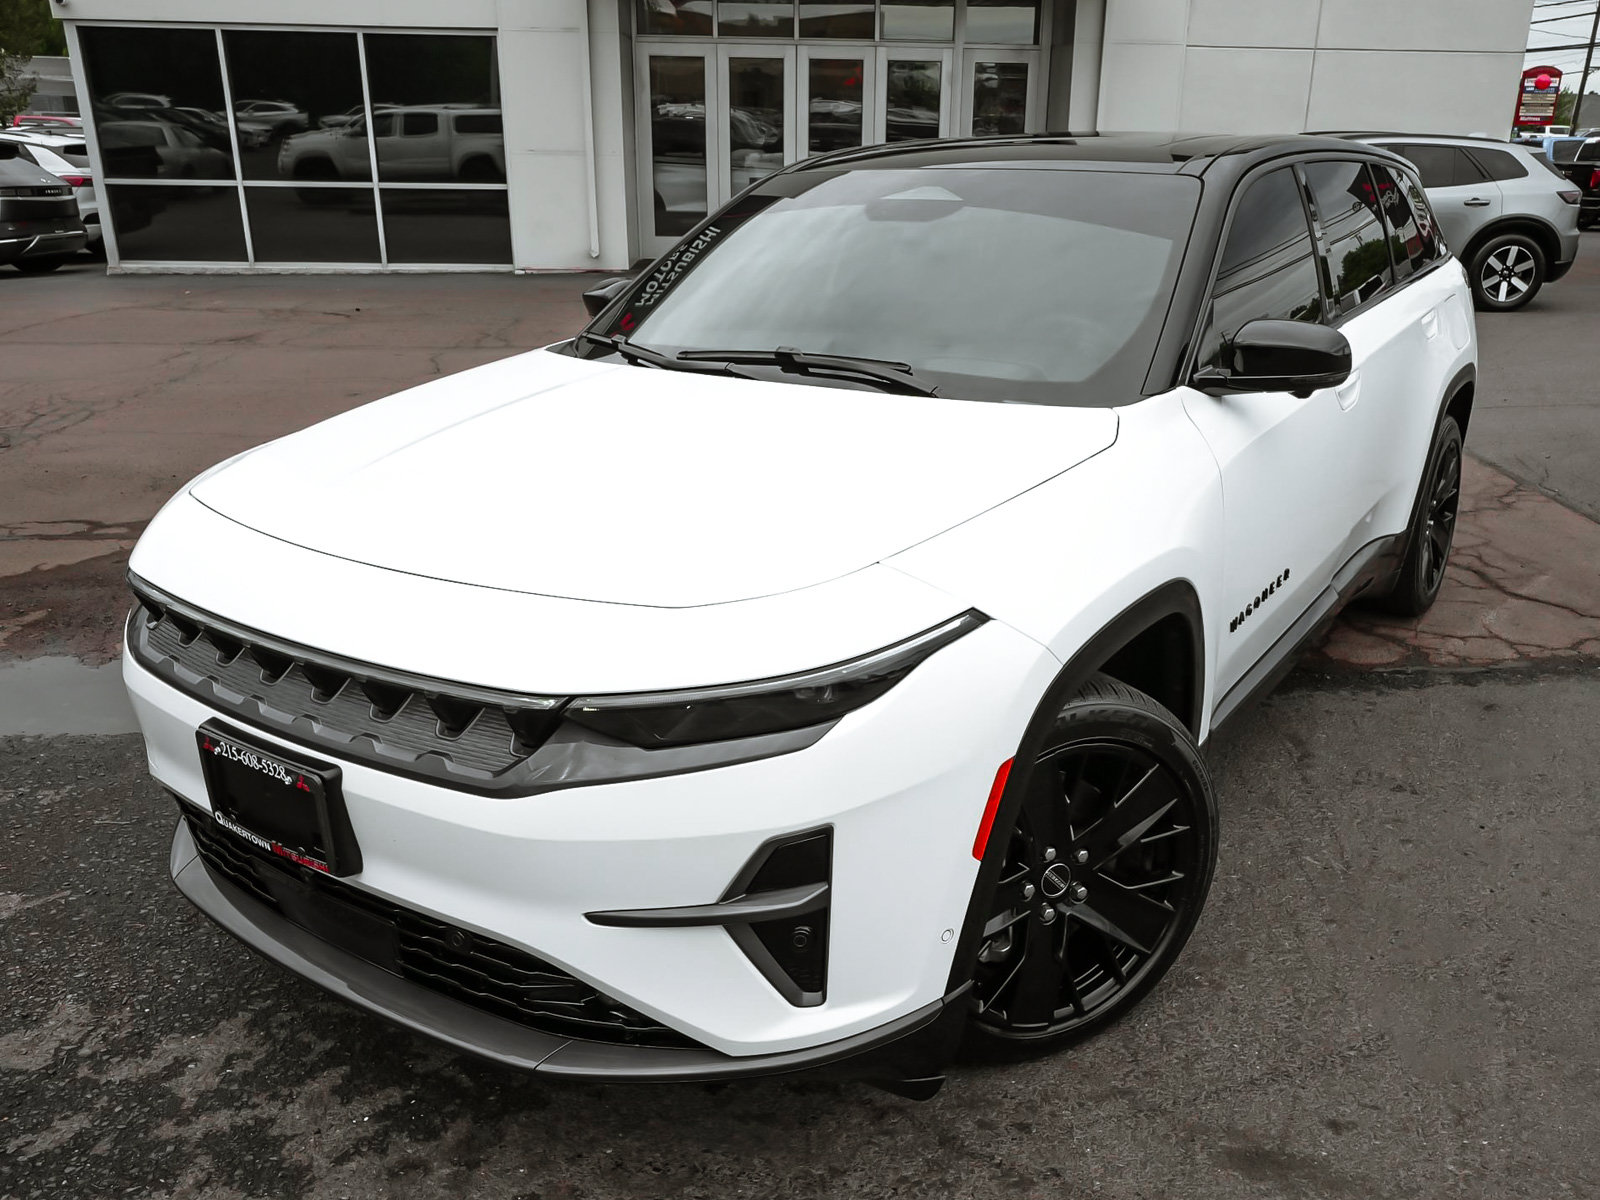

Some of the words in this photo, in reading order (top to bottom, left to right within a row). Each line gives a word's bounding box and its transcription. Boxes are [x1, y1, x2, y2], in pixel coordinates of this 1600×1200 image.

[1229, 568, 1290, 633] WAGONEER
[219, 741, 287, 782] 215-608-5328
[214, 810, 271, 851] QUAKERTOWN
